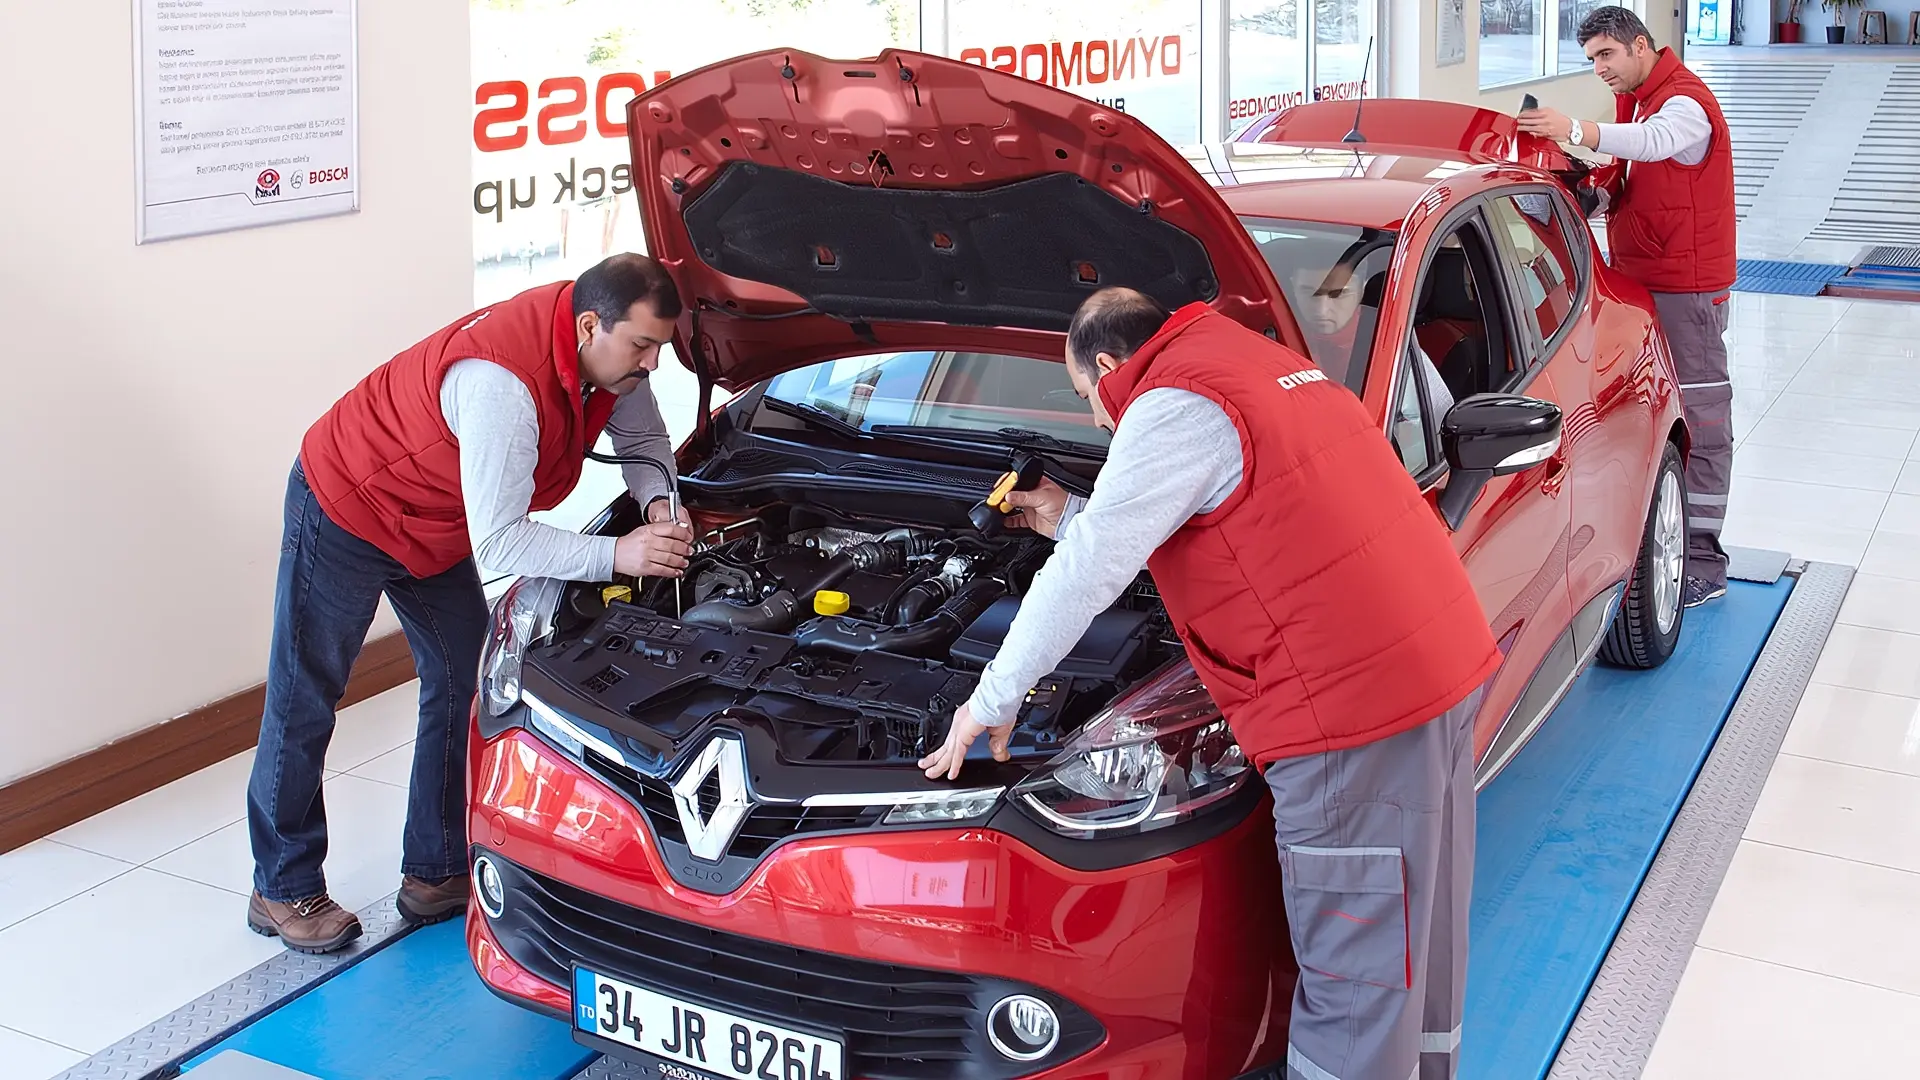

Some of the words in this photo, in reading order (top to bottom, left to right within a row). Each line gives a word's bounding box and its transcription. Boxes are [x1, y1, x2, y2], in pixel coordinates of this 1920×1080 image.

[309, 167, 348, 184] BOSCH
[682, 865, 723, 883] CLIO
[599, 983, 643, 1042] 34
[661, 1005, 707, 1062] JR
[730, 1022, 832, 1080] 8264
